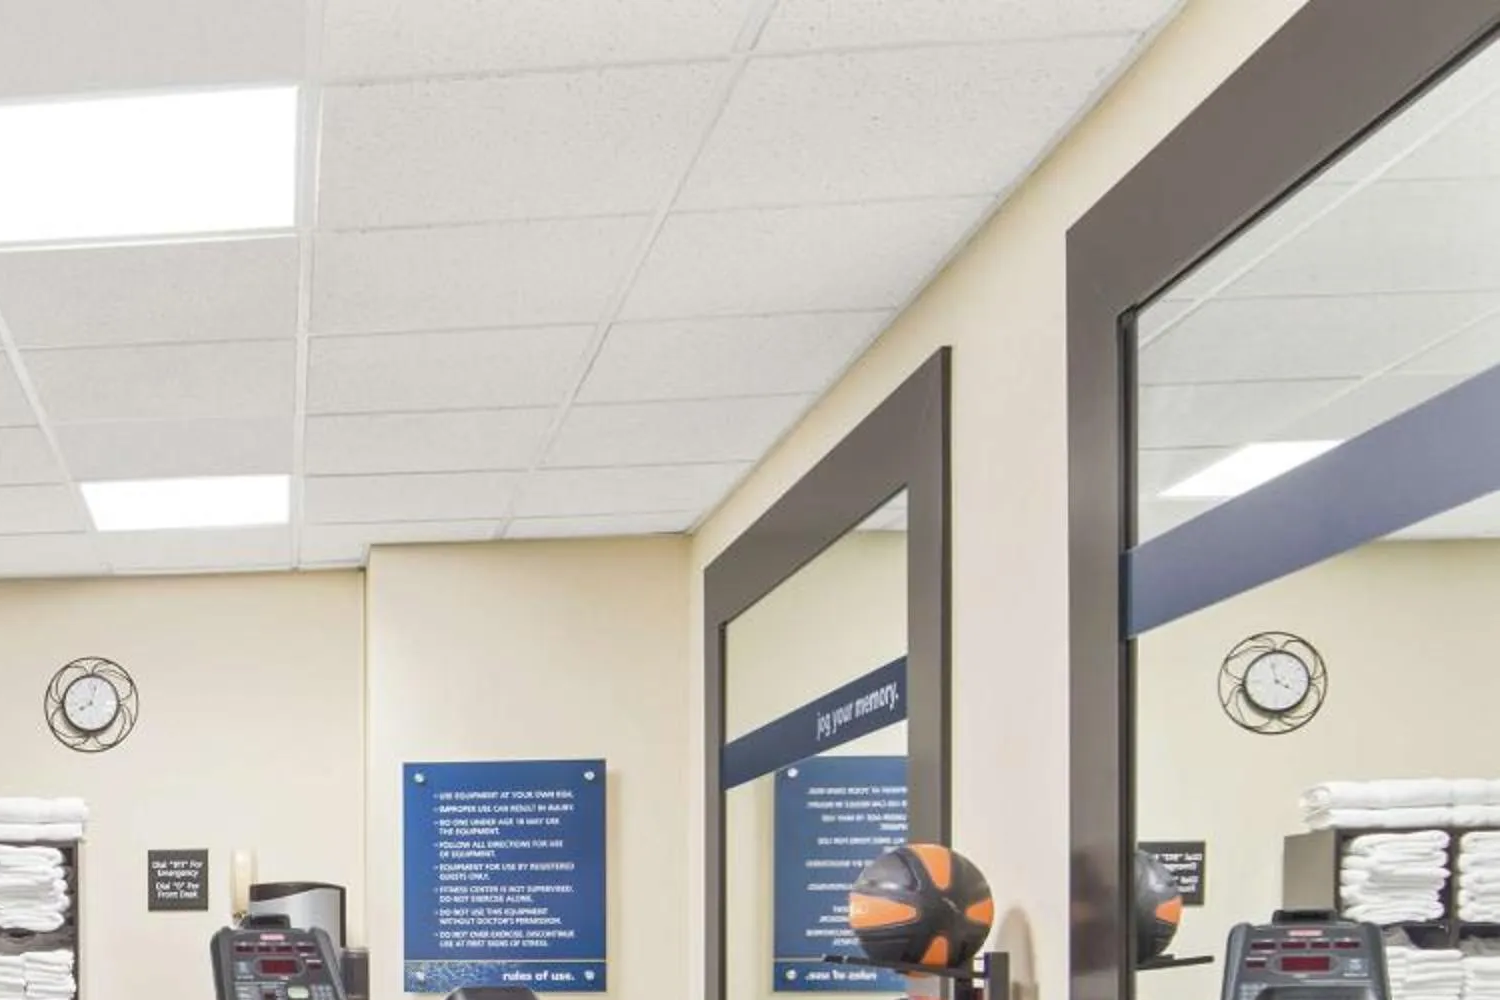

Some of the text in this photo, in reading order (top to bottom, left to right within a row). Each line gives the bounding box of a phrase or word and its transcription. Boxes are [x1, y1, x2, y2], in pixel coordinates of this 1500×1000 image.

[816, 681, 899, 741] jog your memory.
[512, 791, 534, 799] YOUR
[535, 791, 554, 799] OWN
[503, 970, 575, 981] rules of use.
